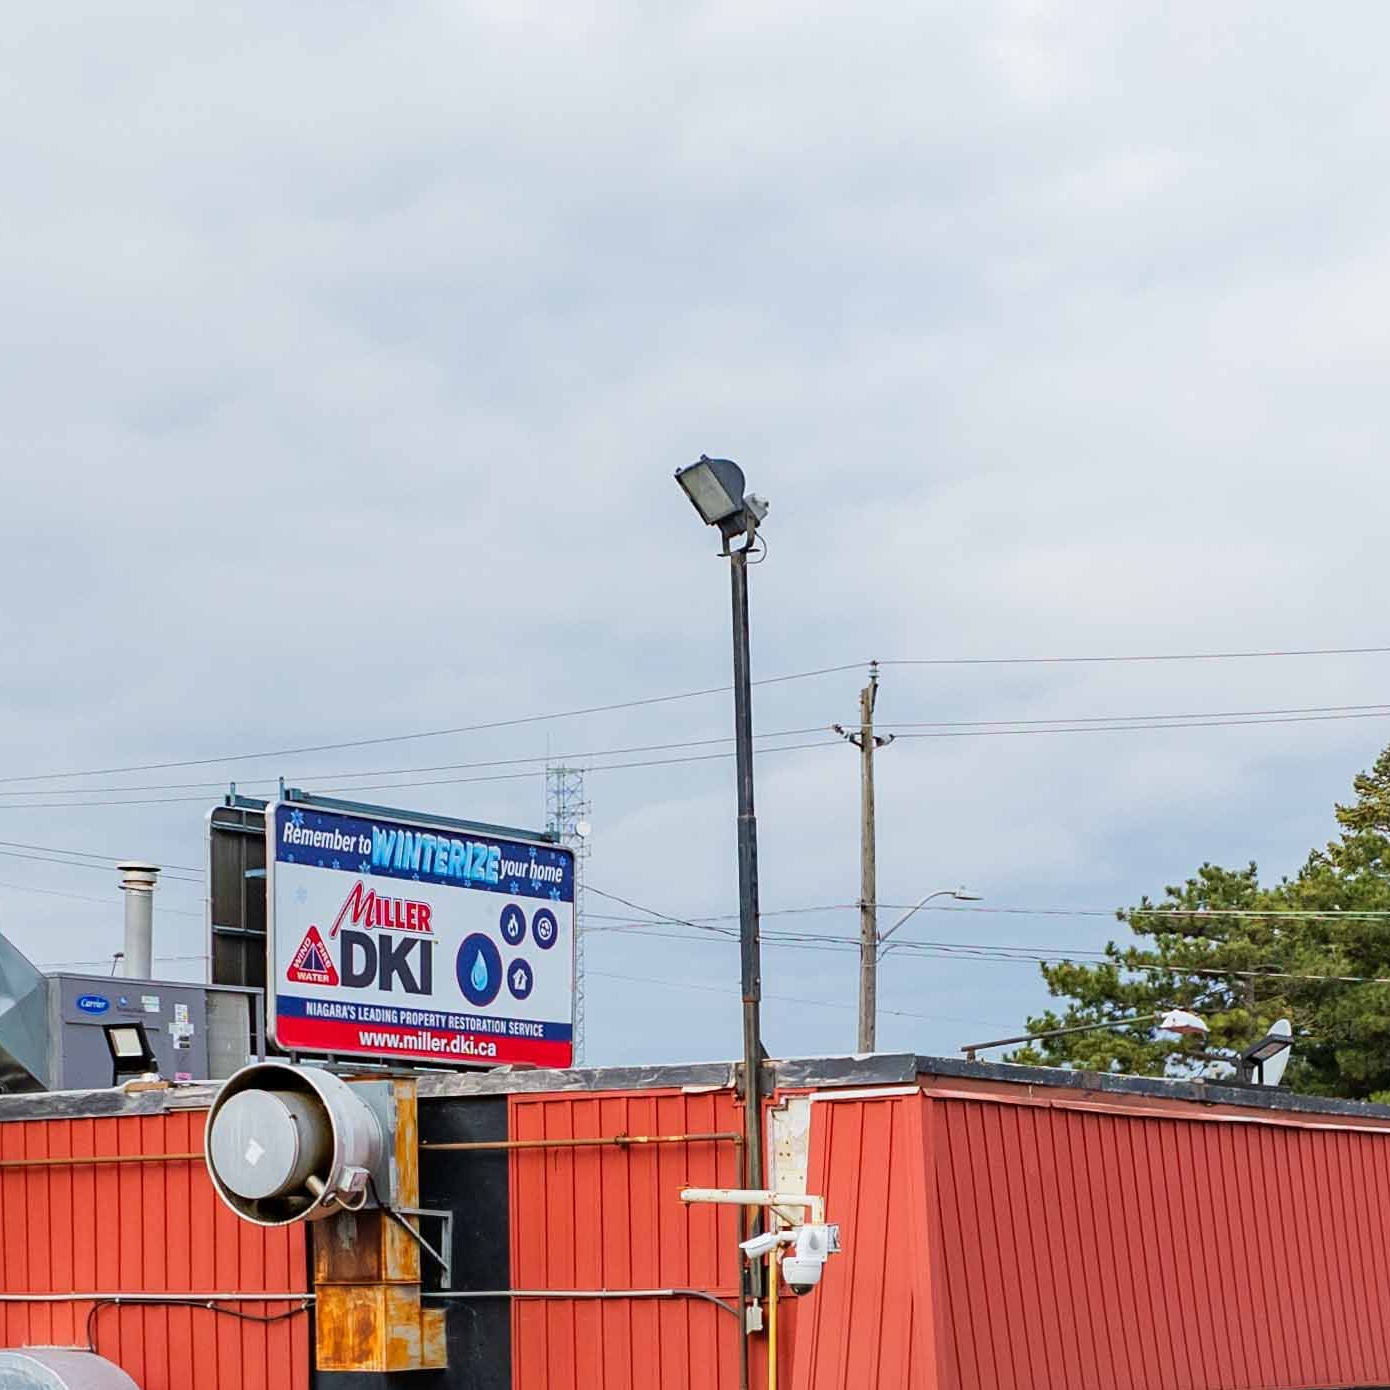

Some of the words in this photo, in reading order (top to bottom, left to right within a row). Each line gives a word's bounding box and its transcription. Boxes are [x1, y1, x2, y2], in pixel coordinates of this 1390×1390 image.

[282, 822, 357, 853] Remember
[358, 834, 371, 855] to
[373, 826, 501, 884] WINTERIZE
[499, 858, 527, 880] your
[529, 860, 563, 883] home
[330, 880, 432, 939] MILLER
[293, 937, 311, 968] WIND
[340, 931, 432, 995] DKI
[297, 972, 330, 983] WATER
[81, 999, 105, 1009] Carrier
[306, 1001, 356, 1019] NIAGARA'S
[358, 1006, 398, 1024] LEADING
[400, 1011, 446, 1029] PROPERTY
[448, 1015, 507, 1034] RESTORATION
[508, 1021, 544, 1038] SERVICE
[359, 1030, 497, 1057] www.miller.dki.ca
